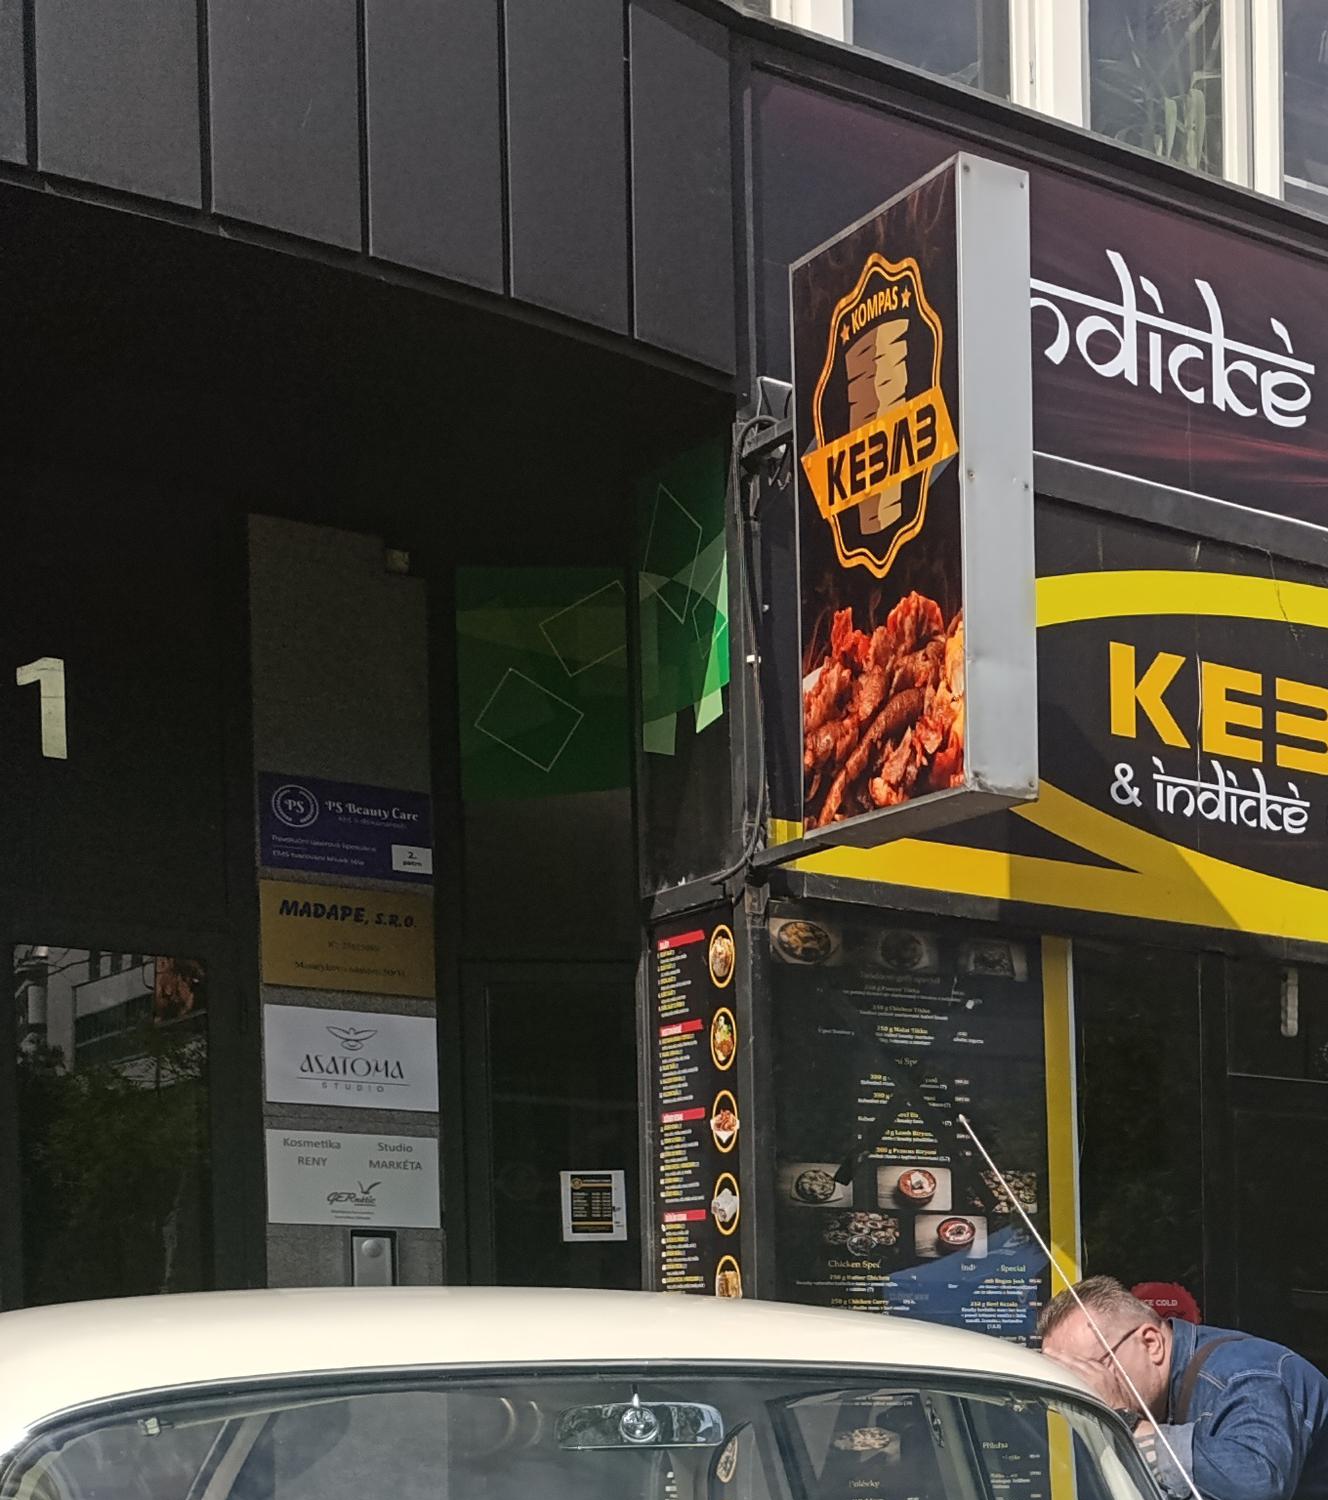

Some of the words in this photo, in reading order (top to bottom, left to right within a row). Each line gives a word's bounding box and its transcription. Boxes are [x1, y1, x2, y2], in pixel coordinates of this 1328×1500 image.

[851, 285, 899, 334] KOMPAS
[827, 404, 937, 507] KEBAB
[15, 656, 69, 761] 1
[1111, 763, 1142, 807] &
[325, 800, 344, 814] PS
[345, 802, 389, 820] Beauty
[391, 808, 420, 822] Care
[280, 899, 369, 925] MADAPE,
[300, 1054, 404, 1079] ASATOMA
[321, 1081, 384, 1093] STUDIO
[283, 1137, 341, 1150] Kosmetika
[378, 1142, 413, 1153] Studio
[298, 1156, 327, 1167] RENY
[369, 1159, 422, 1171] MARKÉTA
